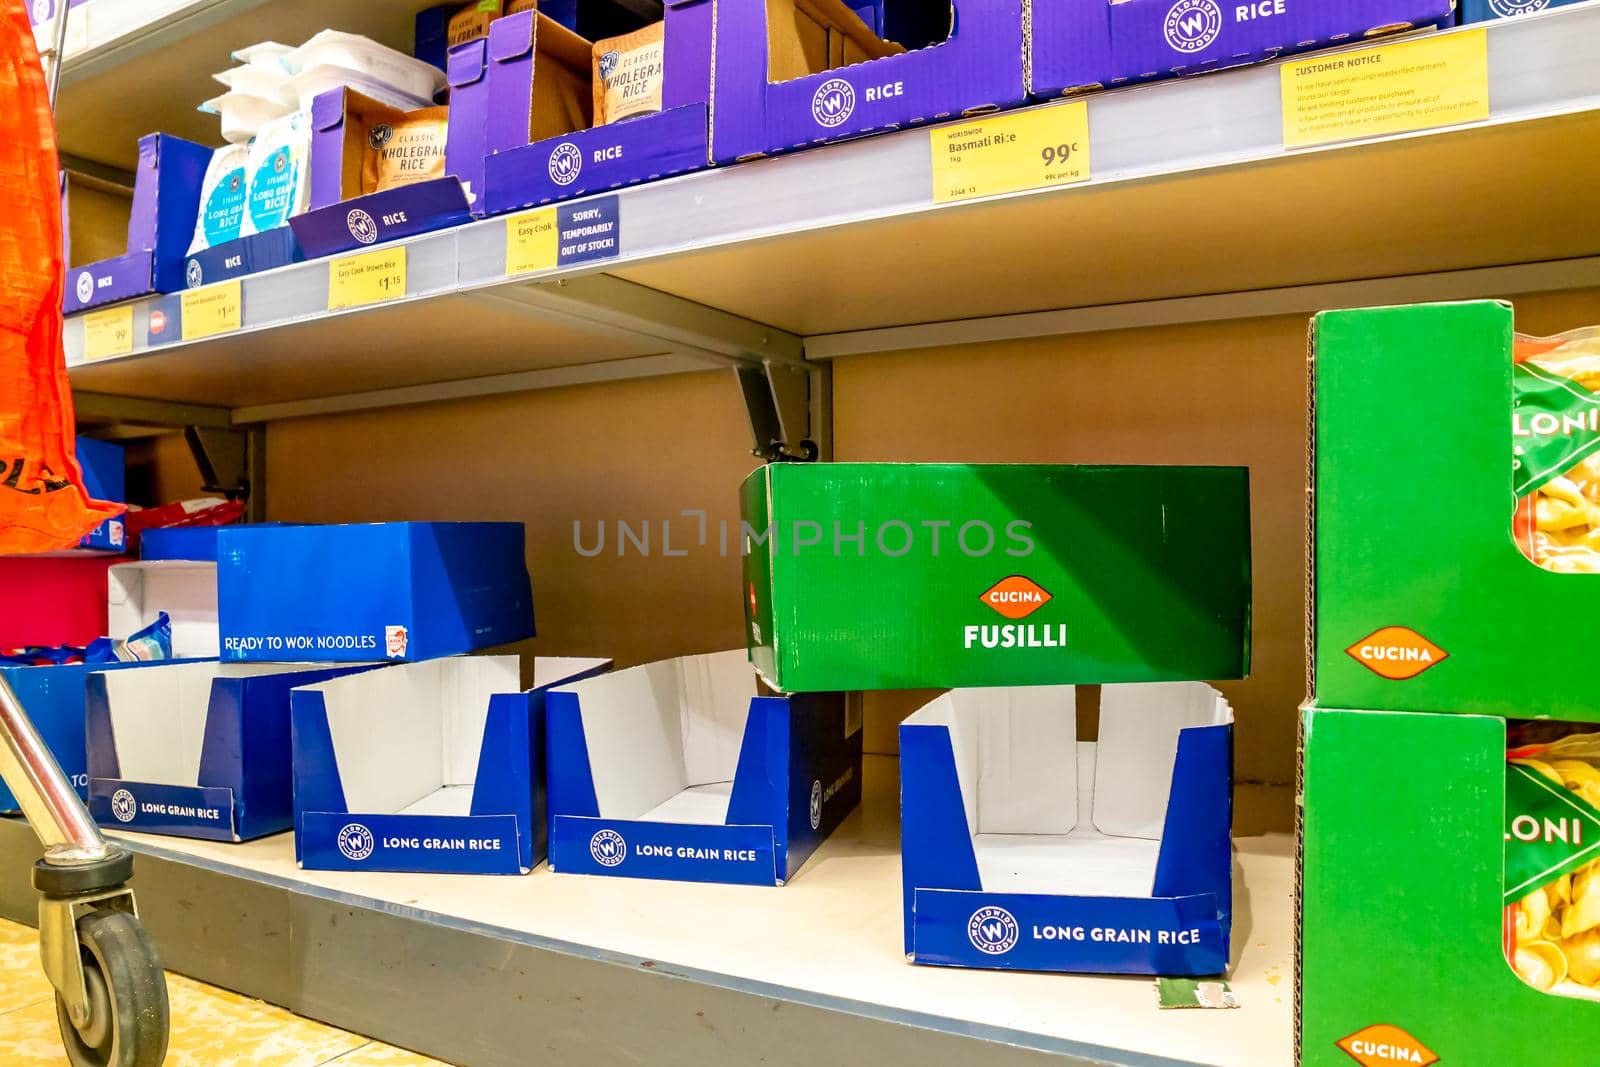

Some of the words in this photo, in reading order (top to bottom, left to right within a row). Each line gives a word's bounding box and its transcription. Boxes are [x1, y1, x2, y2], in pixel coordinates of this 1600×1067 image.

[1236, 0, 1286, 22] RICE
[624, 50, 659, 67] CLASSIC
[1296, 61, 1344, 76] CUSTOMER
[1347, 54, 1382, 67] NOTICE
[623, 80, 648, 99] RICE
[865, 81, 903, 102] RICE
[399, 134, 434, 143] CLASSIC
[949, 137, 991, 153] Basmati
[593, 145, 623, 163] RICE
[400, 158, 425, 171] RICE
[253, 188, 275, 201] LONG
[264, 195, 286, 211] RICE
[208, 208, 229, 220] LONG
[219, 214, 239, 229] RICE
[382, 212, 407, 226] RICE
[572, 208, 601, 222] SORRY,
[518, 227, 534, 236] Easy
[535, 222, 552, 233] Cook
[562, 222, 614, 240] TEMPORARILY
[561, 246, 577, 256] OUT
[577, 243, 588, 253] OF
[588, 238, 614, 251] STOCK!
[225, 255, 242, 269] RICE
[990, 591, 1042, 603] CUCINA
[225, 637, 263, 650] READY
[266, 637, 282, 650] TO
[285, 636, 314, 649] WOK
[317, 635, 377, 649] NOODLES
[964, 623, 1067, 649] FUSILLI
[1360, 645, 1433, 662] CUCINA
[71, 774, 88, 788] TO
[141, 803, 166, 815] LONG
[167, 807, 195, 817] GRAIN
[197, 808, 219, 819] RICE
[1504, 815, 1583, 846] ONI
[383, 837, 419, 849] LONG
[423, 838, 465, 849] GRAIN
[469, 838, 500, 850] RICE
[636, 845, 672, 857] LONG
[677, 847, 719, 860] GRAIN
[724, 850, 756, 861] RICE
[982, 922, 1002, 941] W
[1033, 926, 1085, 941] LONG
[1090, 927, 1150, 943] GRAIN
[1158, 929, 1200, 945] RICE
[1351, 1039, 1423, 1064] CUCINA
